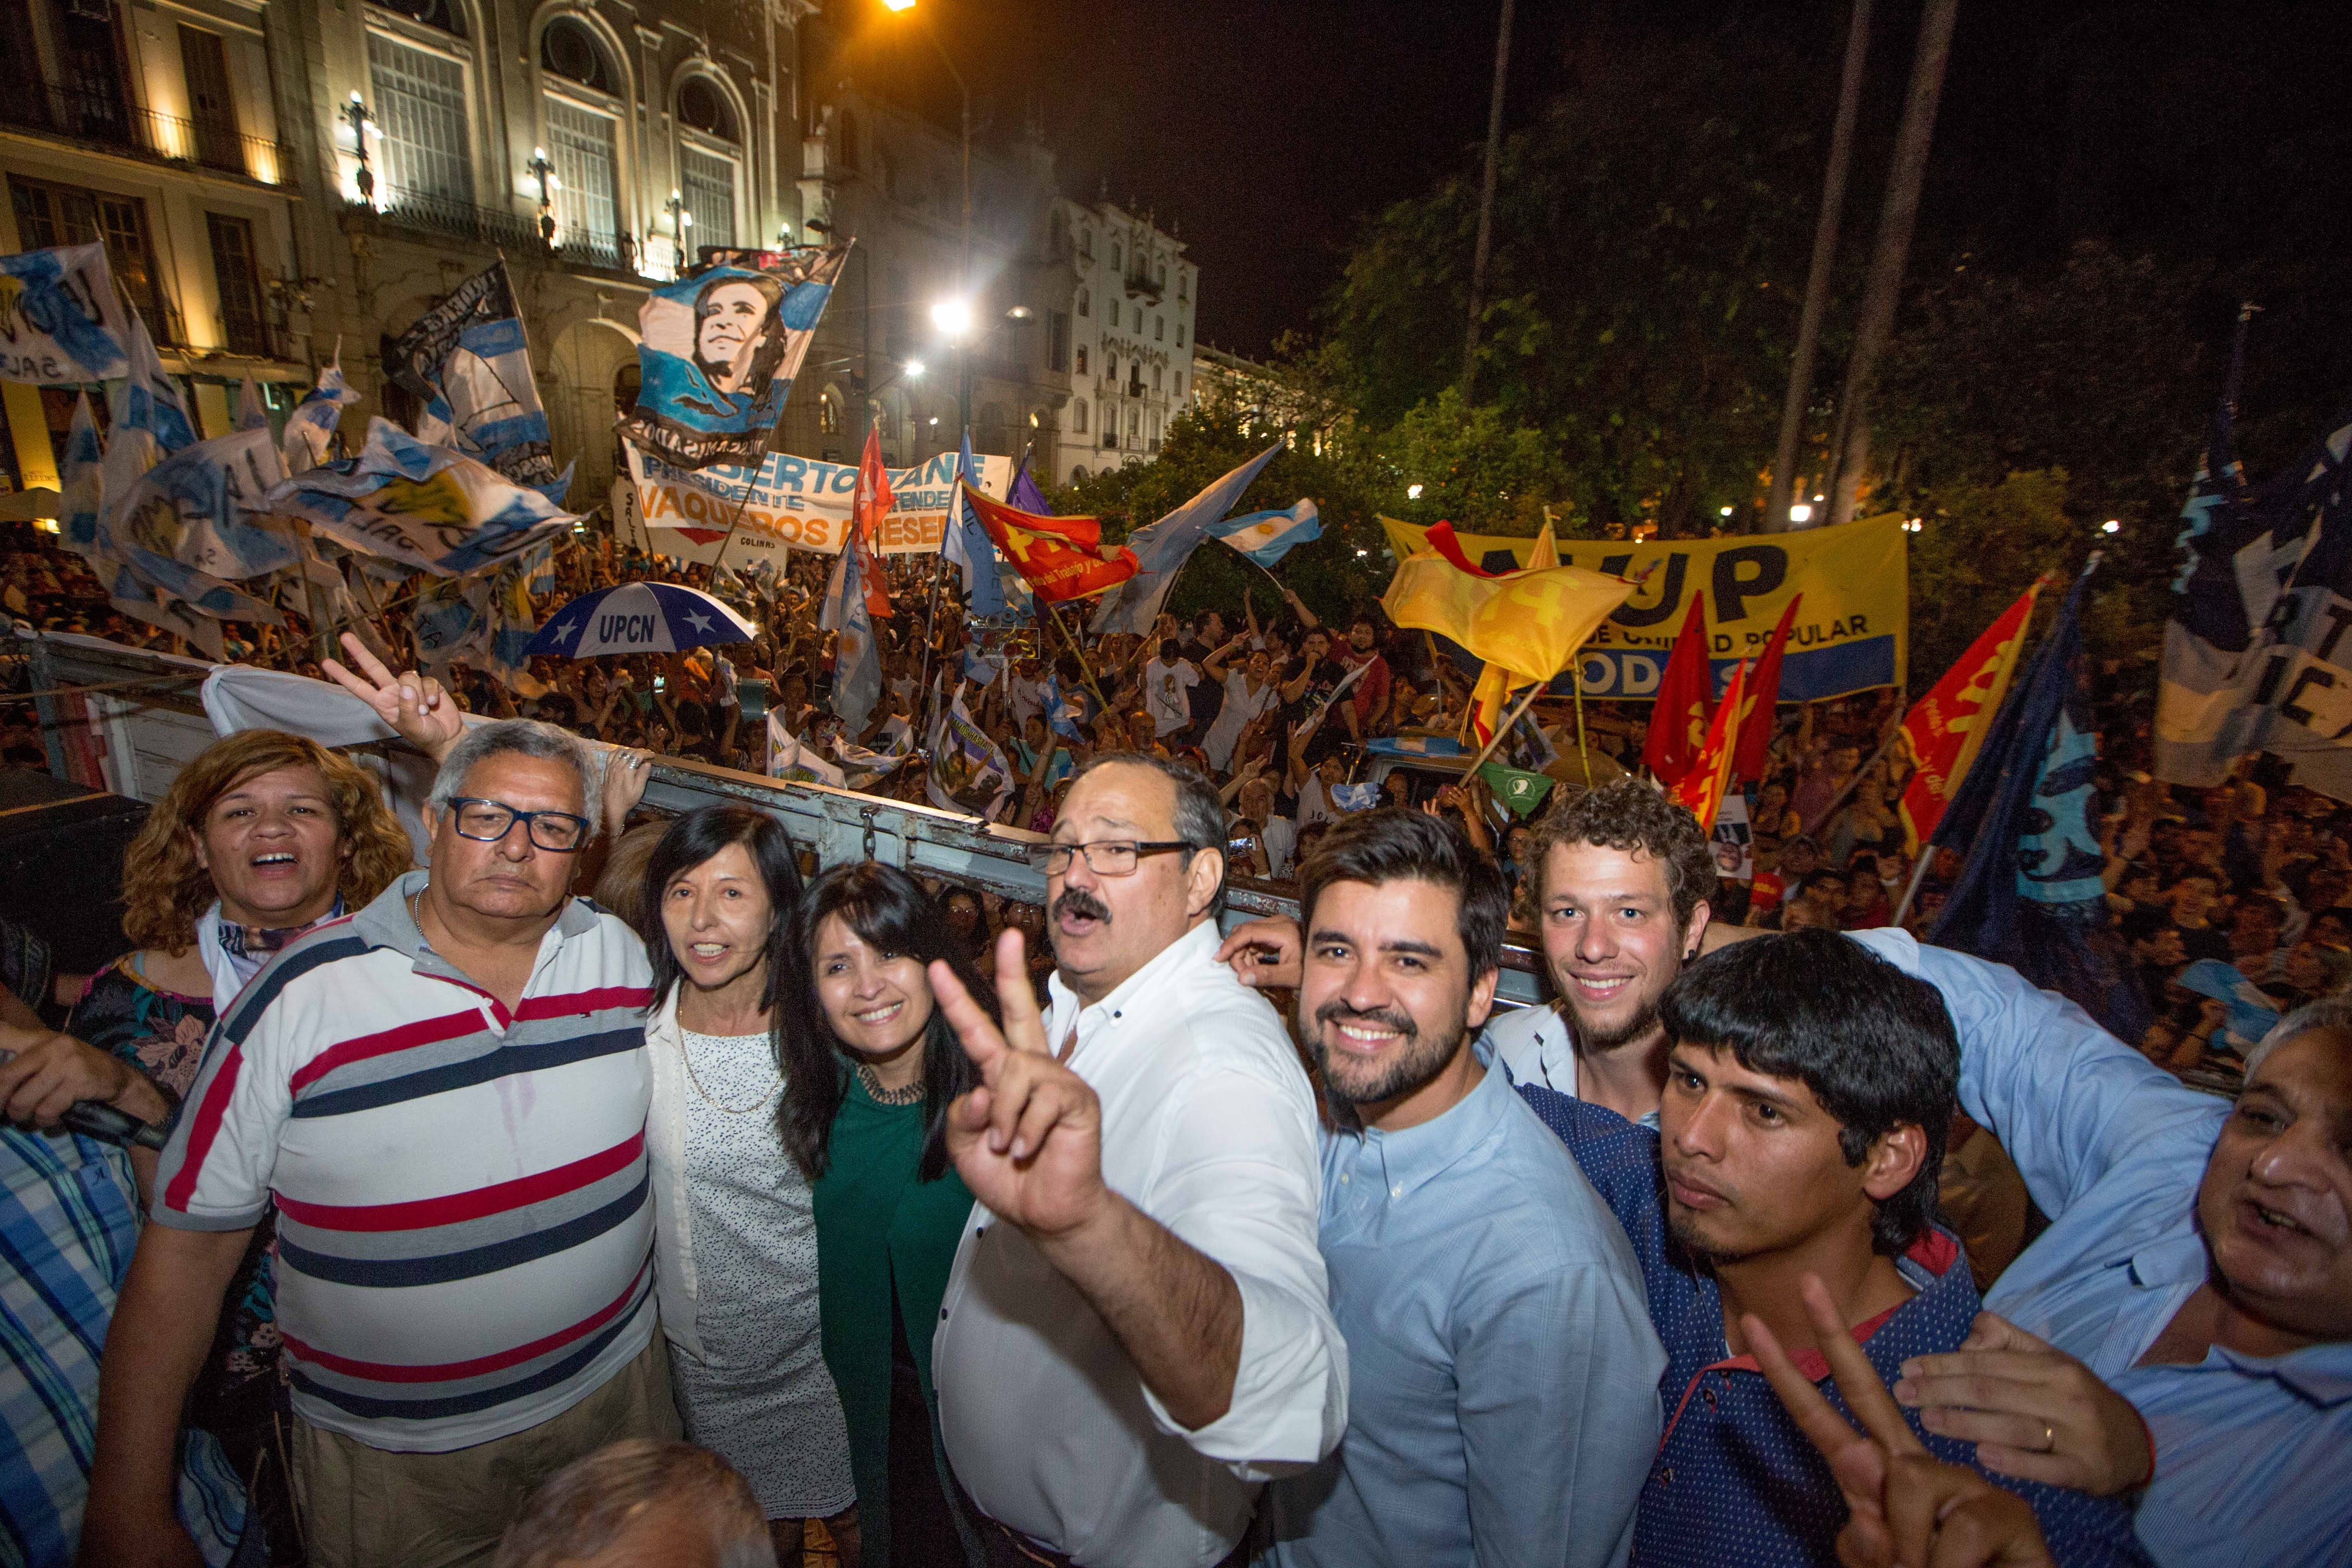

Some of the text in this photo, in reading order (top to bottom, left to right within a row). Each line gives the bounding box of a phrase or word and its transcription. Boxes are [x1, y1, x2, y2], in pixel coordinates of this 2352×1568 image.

[643, 455, 804, 511] PRESIDENTE
[638, 485, 829, 546] VAQUEROS
[598, 614, 656, 644] UPCN
